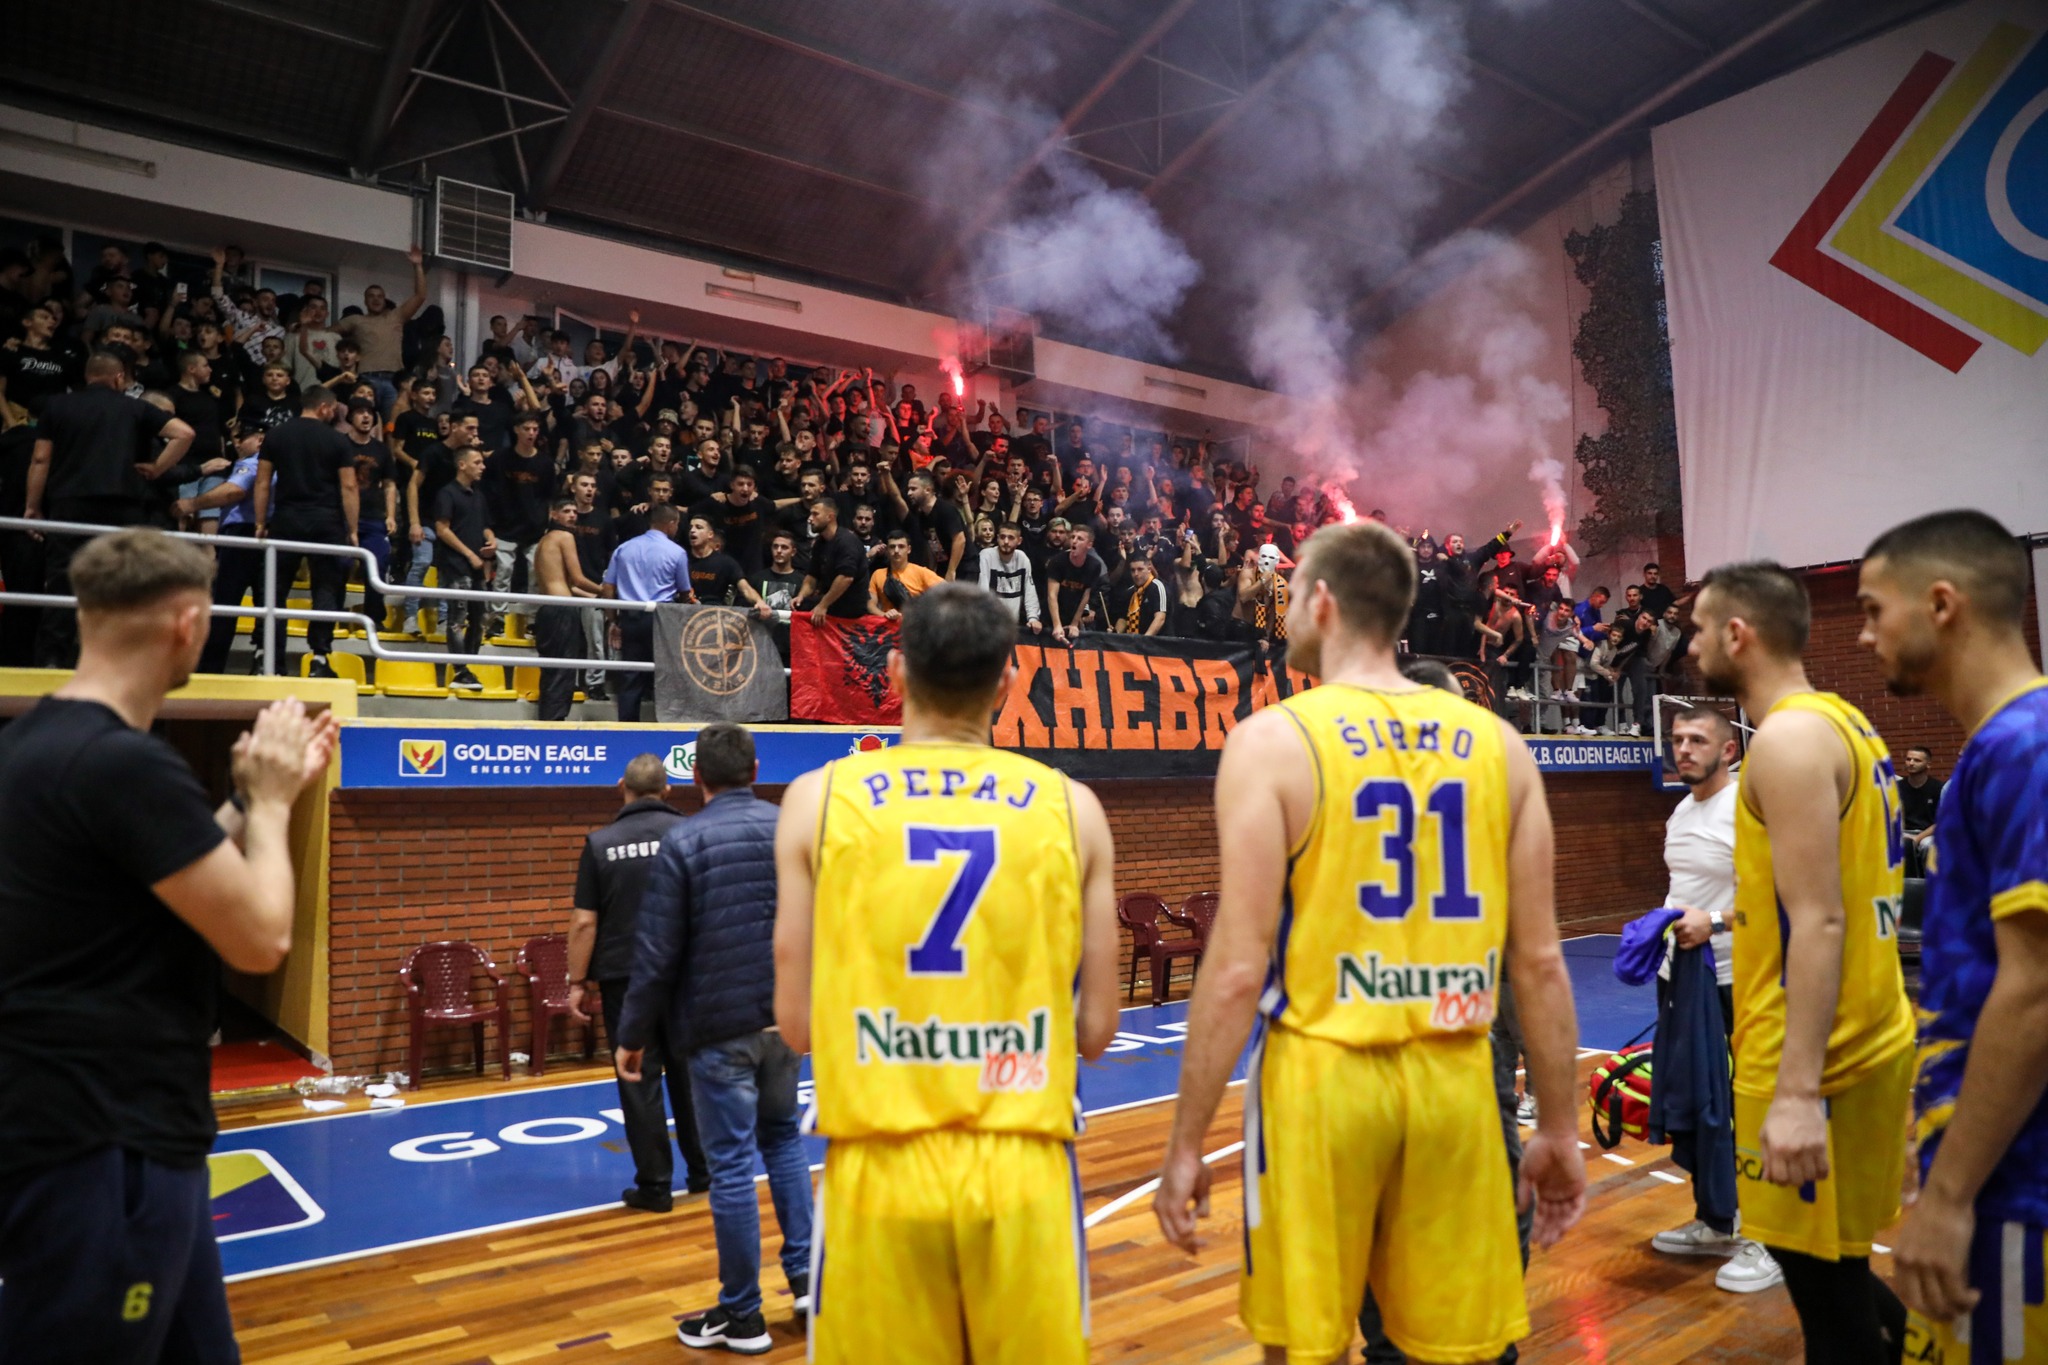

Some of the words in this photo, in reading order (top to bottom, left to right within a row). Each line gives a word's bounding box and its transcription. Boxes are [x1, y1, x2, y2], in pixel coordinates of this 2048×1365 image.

[991, 644, 1322, 750] XHEBRA
[453, 744, 540, 761] GOLDEN
[545, 745, 607, 761] EAGLE
[471, 765, 532, 774] ENERGY
[544, 765, 591, 774] DRINK
[673, 747, 697, 771] Re
[1555, 747, 1603, 764] GOLDEN
[1606, 747, 1640, 764] EAGLE
[863, 768, 1037, 809] PEPAJ
[1354, 778, 1483, 921] 31
[905, 824, 999, 977] 7
[856, 1009, 1048, 1061] Natural
[122, 1281, 153, 1322] 6
